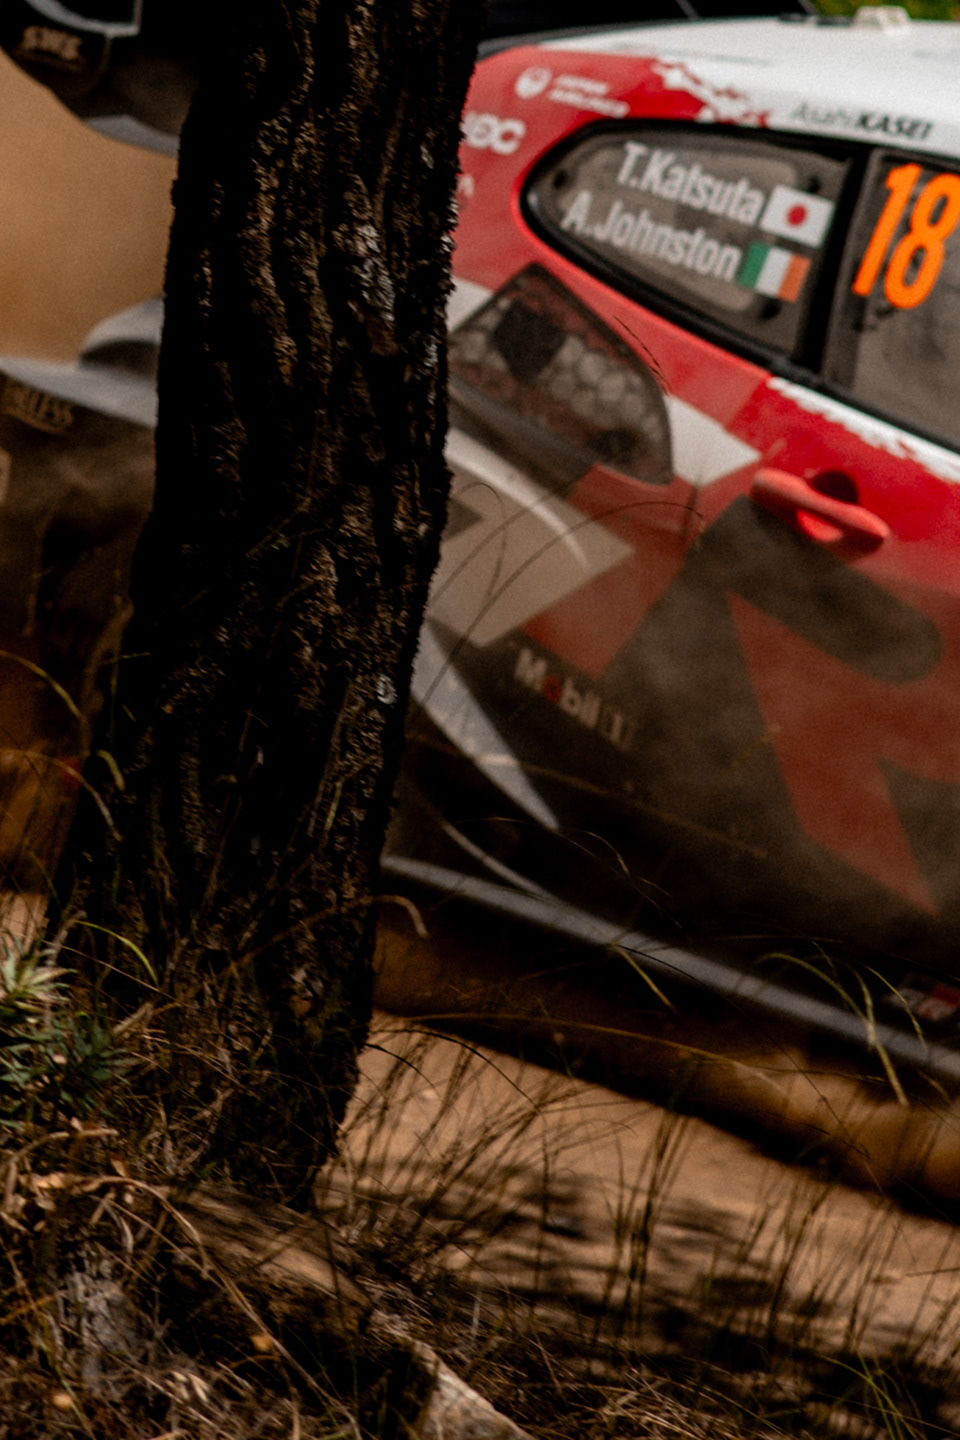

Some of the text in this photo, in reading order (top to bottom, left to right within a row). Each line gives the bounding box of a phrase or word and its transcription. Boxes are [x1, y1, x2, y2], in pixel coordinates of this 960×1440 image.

[614, 142, 766, 225] T.Katsuta
[562, 190, 744, 281] A.Johnston
[852, 162, 960, 309] 18
